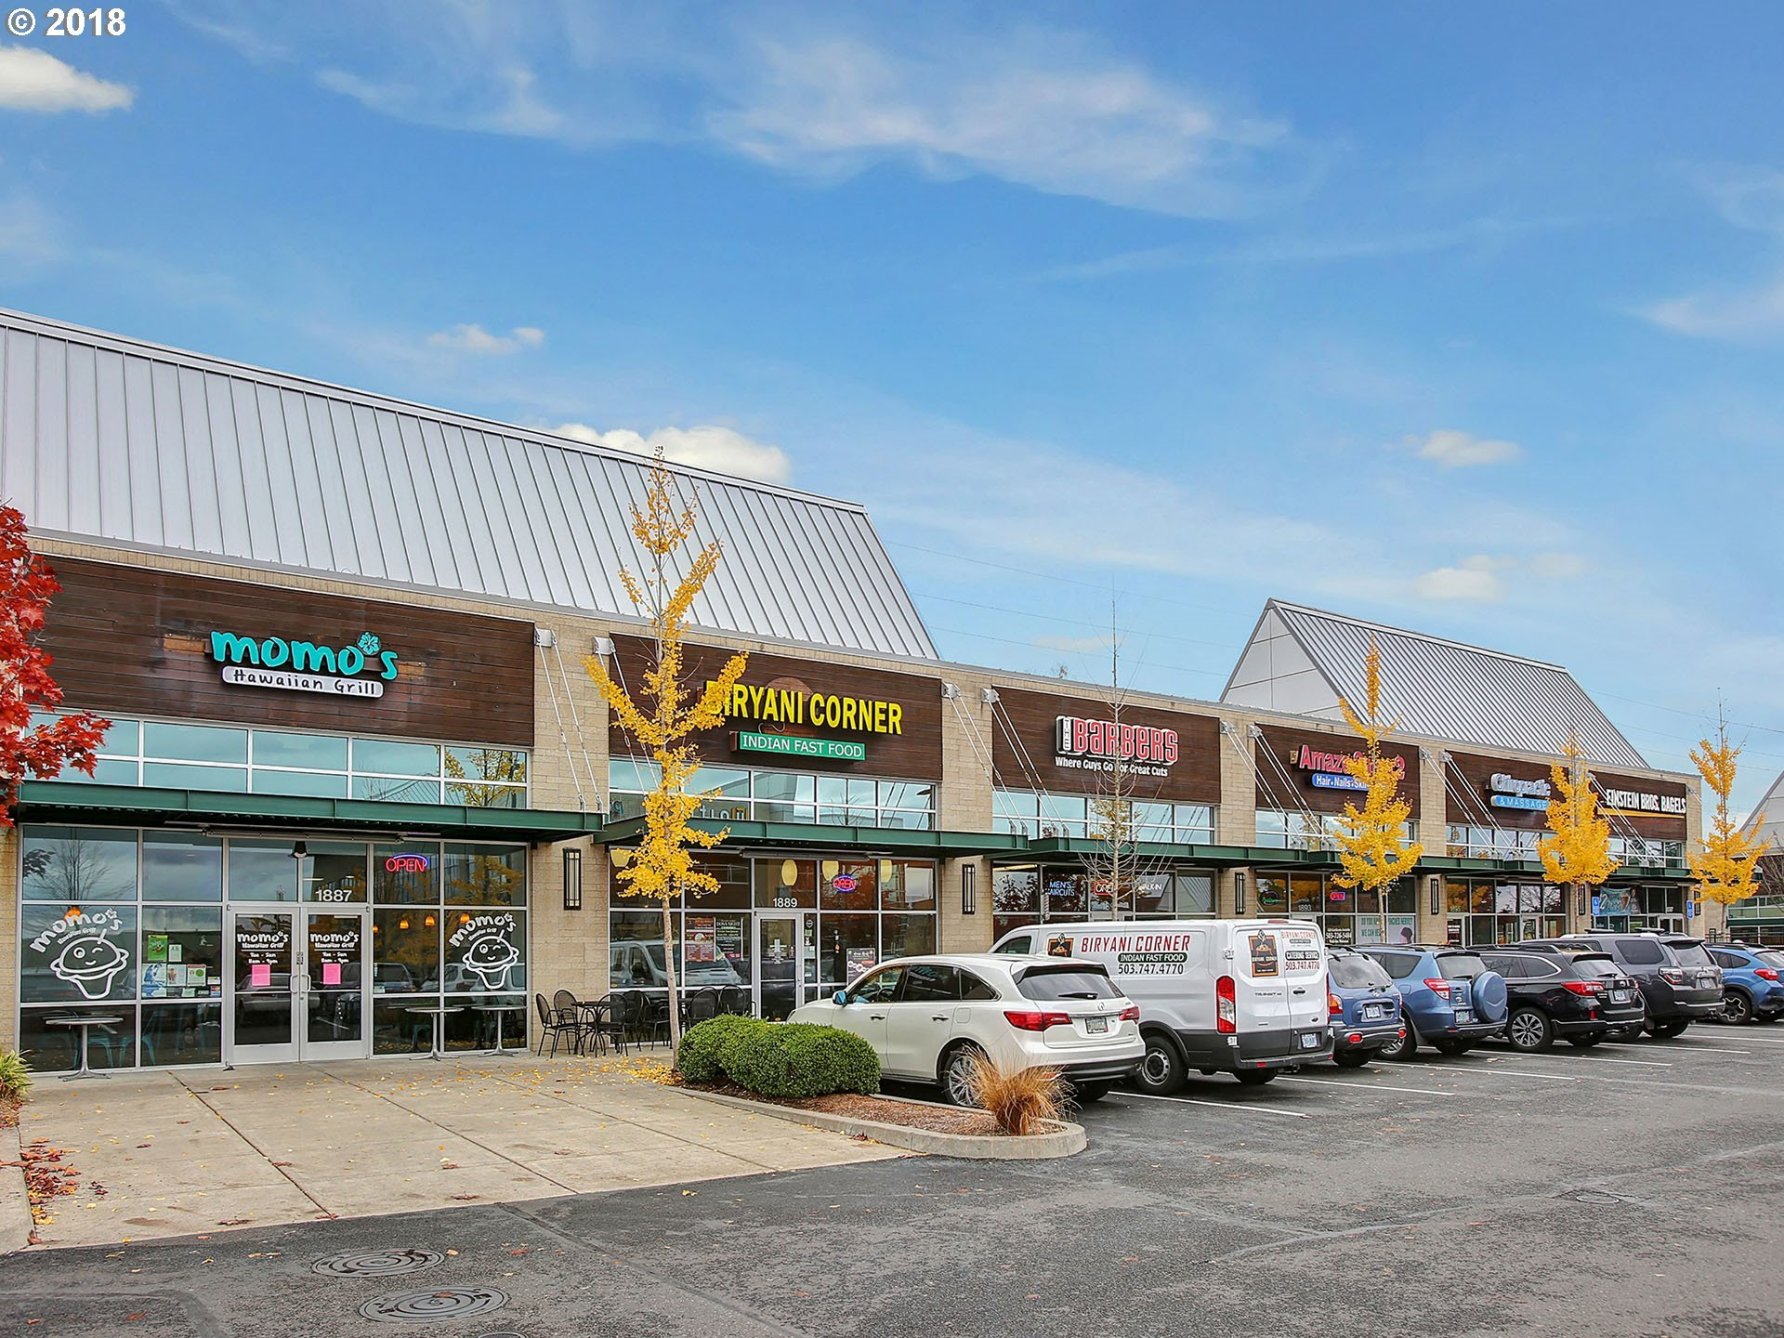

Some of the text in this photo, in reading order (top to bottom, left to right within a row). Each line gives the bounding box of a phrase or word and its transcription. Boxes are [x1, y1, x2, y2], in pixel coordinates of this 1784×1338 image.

[210, 630, 398, 681] momo's
[233, 669, 375, 695] Hawaiian Grill
[809, 692, 902, 735] CORNER
[743, 734, 863, 758] INDIAN FAST FOOD
[1055, 756, 1084, 770] Where
[1083, 759, 1102, 772] Guys
[1102, 762, 1114, 772] Go
[1129, 764, 1151, 776] Great
[1151, 766, 1168, 777] Cuts
[1316, 775, 1331, 786] Hair
[1334, 777, 1351, 788] Nails
[1507, 798, 1548, 809] MASSAGE
[1606, 789, 1686, 814] EINSTEIN BROS. BAGELS
[386, 857, 425, 873] OPEN
[315, 889, 352, 902] 1887
[773, 897, 798, 908] 1889
[30, 908, 122, 953] momo's
[237, 930, 288, 942] momo's
[310, 930, 359, 942] momo's
[449, 913, 516, 948] momo's
[1081, 935, 1191, 953] BIRYANI CORNER
[1120, 952, 1185, 962] INDIAN FAST FOOD
[1118, 963, 1184, 975] 503.747.4770
